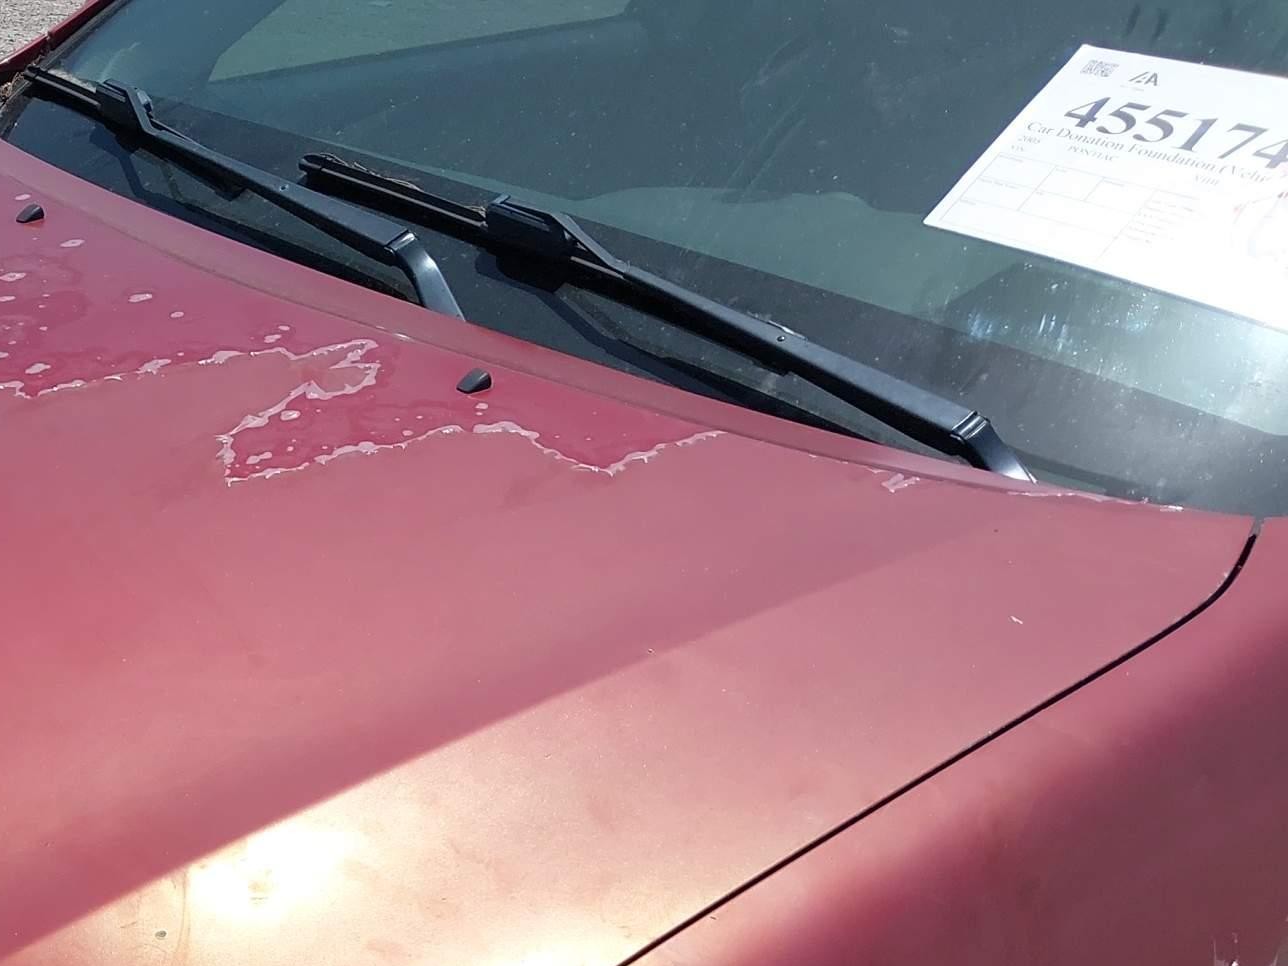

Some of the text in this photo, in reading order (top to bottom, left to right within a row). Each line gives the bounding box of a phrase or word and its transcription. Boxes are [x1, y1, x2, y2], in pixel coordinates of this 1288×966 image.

[1026, 121, 1055, 135] Car
[1055, 127, 1125, 151] Donation
[1127, 142, 1215, 171] Foundation
[1064, 97, 1288, 169] 455174
